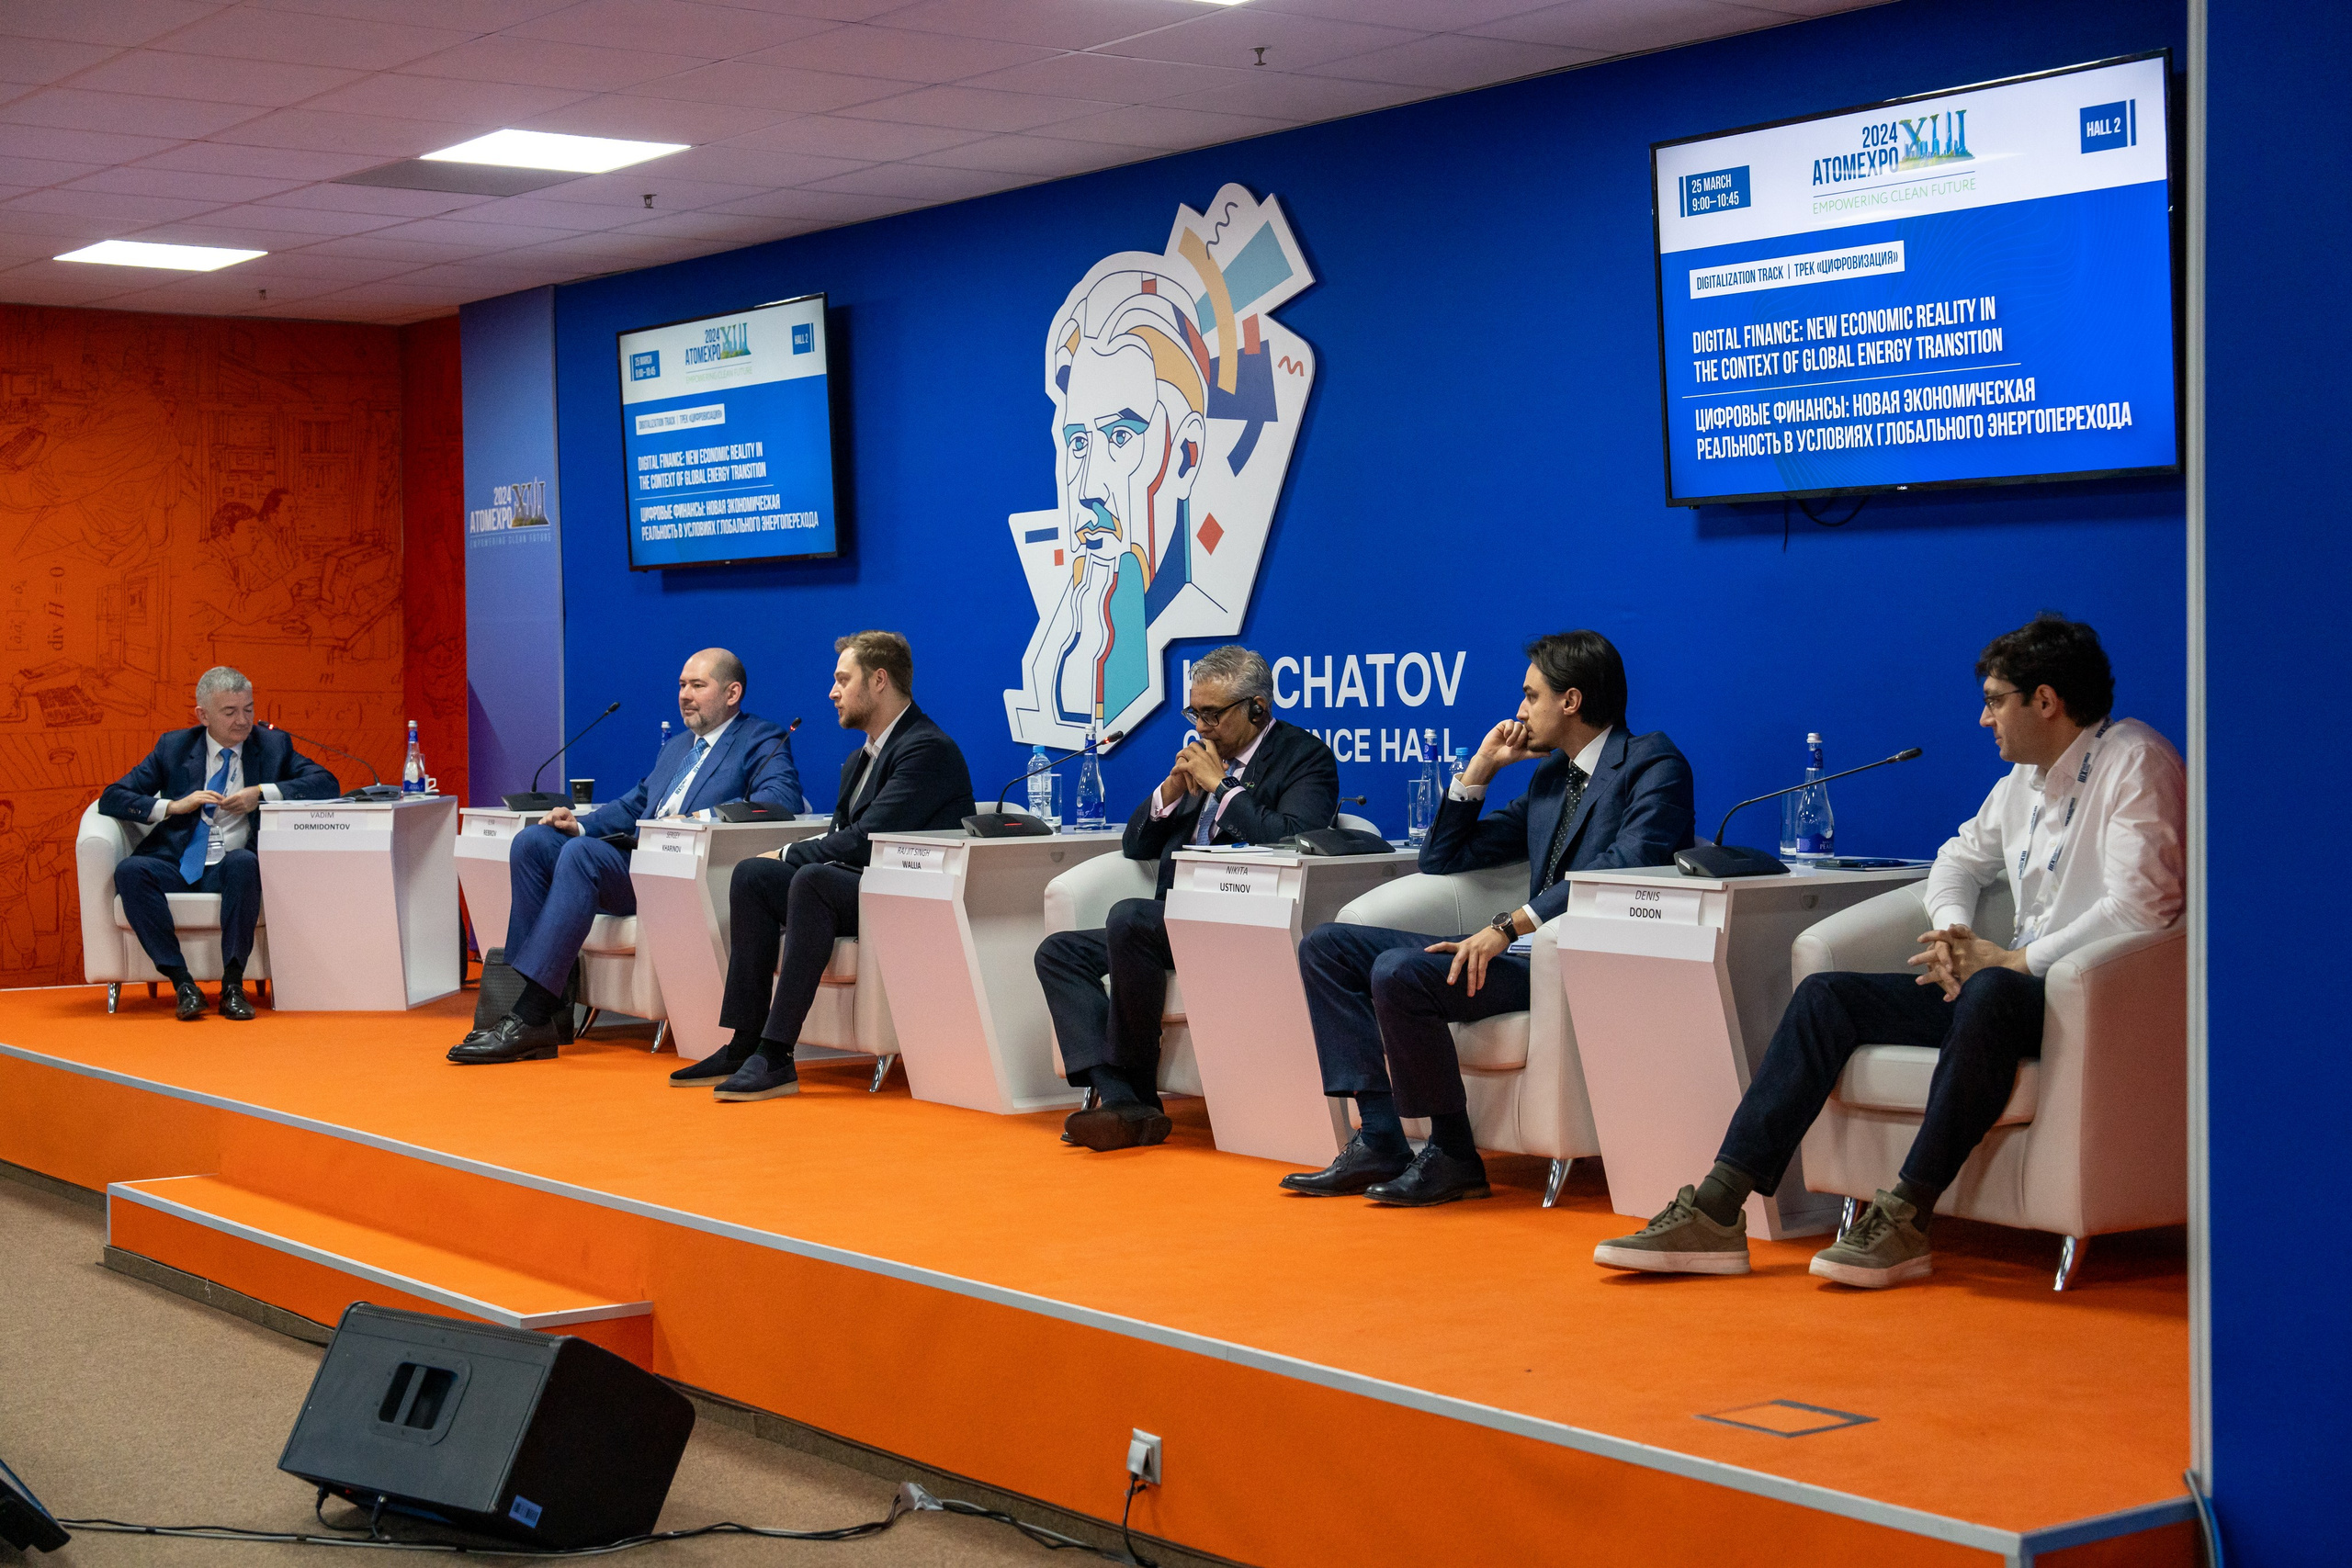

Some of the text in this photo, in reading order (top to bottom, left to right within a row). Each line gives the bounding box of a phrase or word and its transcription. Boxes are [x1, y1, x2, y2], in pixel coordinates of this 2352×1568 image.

[1862, 121, 1897, 148] 2024
[2086, 117, 2121, 138] HALL 2
[1813, 146, 1899, 186] ATOMEXPO
[1691, 174, 1732, 194] 25 MARCH
[1813, 177, 1976, 214] EMPOWERING CLEAN FUTURE
[1696, 265, 1784, 290] DIGITALIZATION TRACK
[1794, 261, 1815, 276] ТРЕК
[705, 328, 720, 344] 2024
[1692, 296, 1996, 354] DIGITAL FINANCE: NEW ECONOMIC REALITY IN
[794, 334, 805, 344] HALL
[685, 344, 721, 366] ATOMEXPO
[1693, 327, 2003, 383] THE CONTEXT OF GLOBAL ENERGY TRANSITION
[1695, 377, 2036, 433] ЦИФРОВЫЕ ФИНАНСЫ: НОВАЯ ЭКОНОМИЧЕСКАЯ
[1696, 401, 2132, 460] РЕАЛЬНОСТЬ В УСЛОВИЯХ ГЛОБАЛЬНОГО ЭНЕРГОПЕРЕХОДА
[638, 455, 660, 471] DIGITAL
[685, 449, 699, 466] NEW
[699, 445, 729, 464] ECONOMIC
[730, 442, 755, 460] REALITY
[755, 441, 763, 457] IN
[639, 461, 767, 491] THE CONTEXT OF GLOBAL ENERGY TRANSITION
[493, 485, 512, 506] 2024
[469, 506, 513, 534] ATOMEXPO
[1182, 650, 1467, 709] CHATOV
[1381, 728, 1456, 762] HAL
[310, 811, 334, 819] VADIM
[1226, 865, 1249, 875] NIKITA
[1219, 882, 1250, 894] USTINOV
[1634, 890, 1661, 902] DENIS
[1629, 907, 1662, 919] DODON
